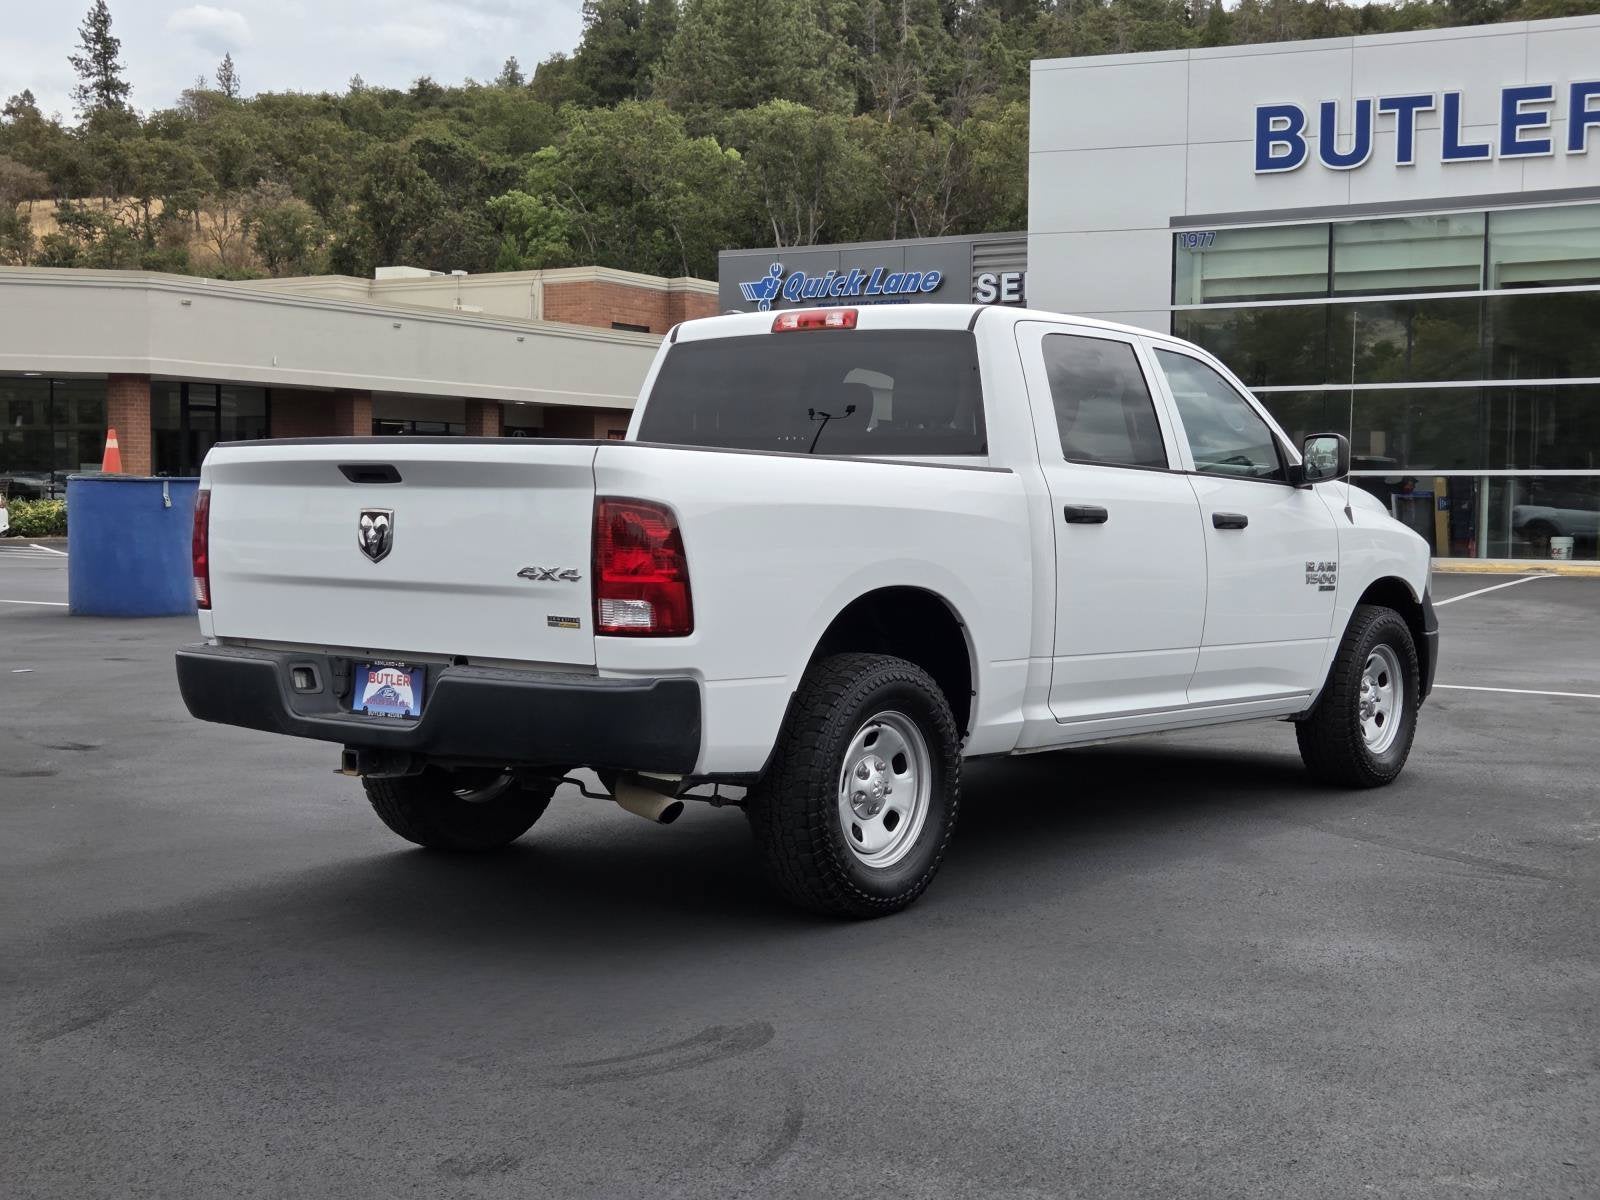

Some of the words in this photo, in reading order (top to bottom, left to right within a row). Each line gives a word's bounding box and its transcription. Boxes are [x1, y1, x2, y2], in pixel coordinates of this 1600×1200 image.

[1254, 81, 1600, 174] BUTLER
[1181, 231, 1216, 248] 1977
[782, 267, 867, 302] Quick
[863, 266, 943, 297] Lane
[976, 271, 1027, 303] SE
[1306, 561, 1337, 572] RAM
[1306, 573, 1337, 585] 1500
[368, 671, 411, 687] BUTLER
